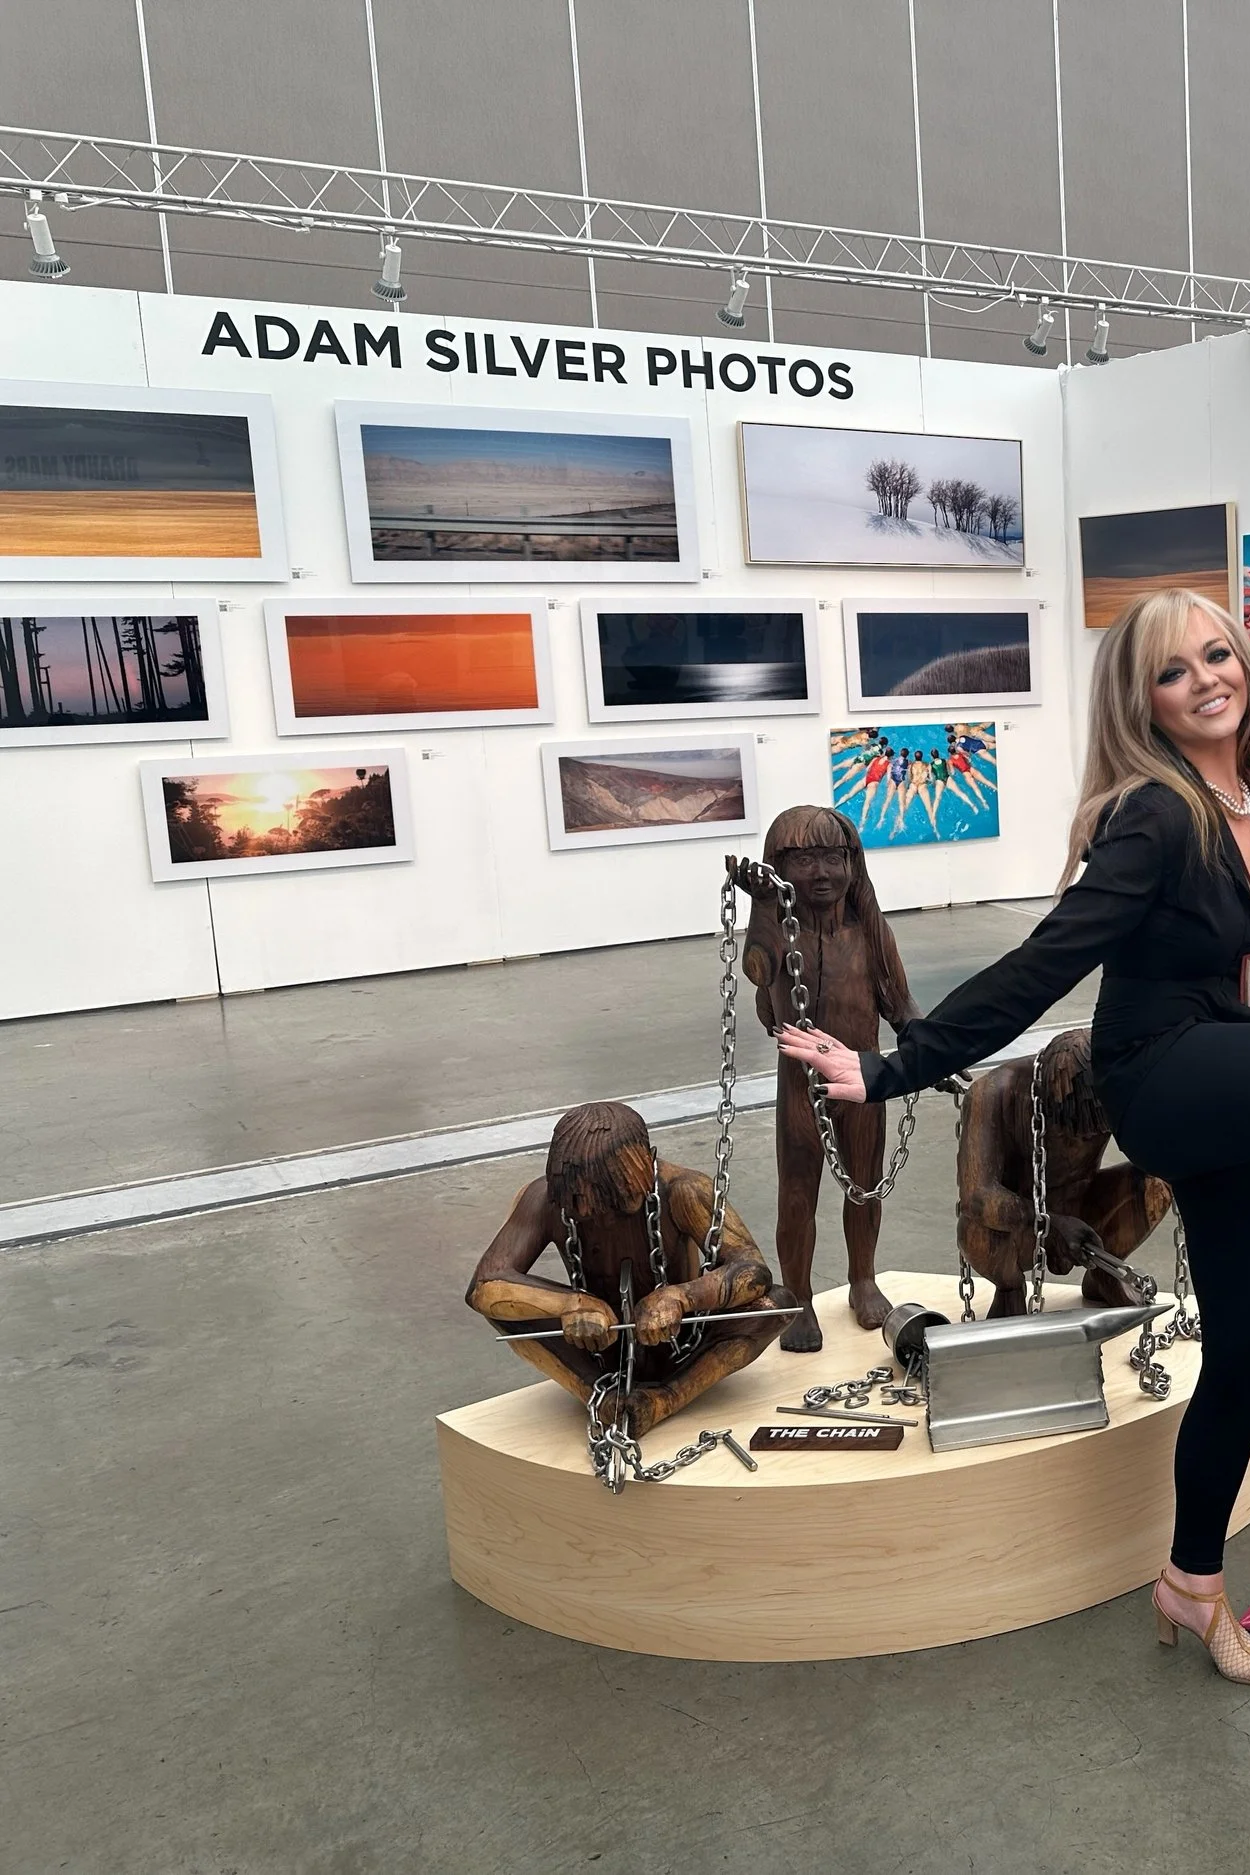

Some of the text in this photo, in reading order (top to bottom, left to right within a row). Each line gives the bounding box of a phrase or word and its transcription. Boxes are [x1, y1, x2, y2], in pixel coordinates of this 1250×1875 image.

[201, 311, 854, 400] ADAM SILVER PHOTOS
[769, 1428, 810, 1437] THE
